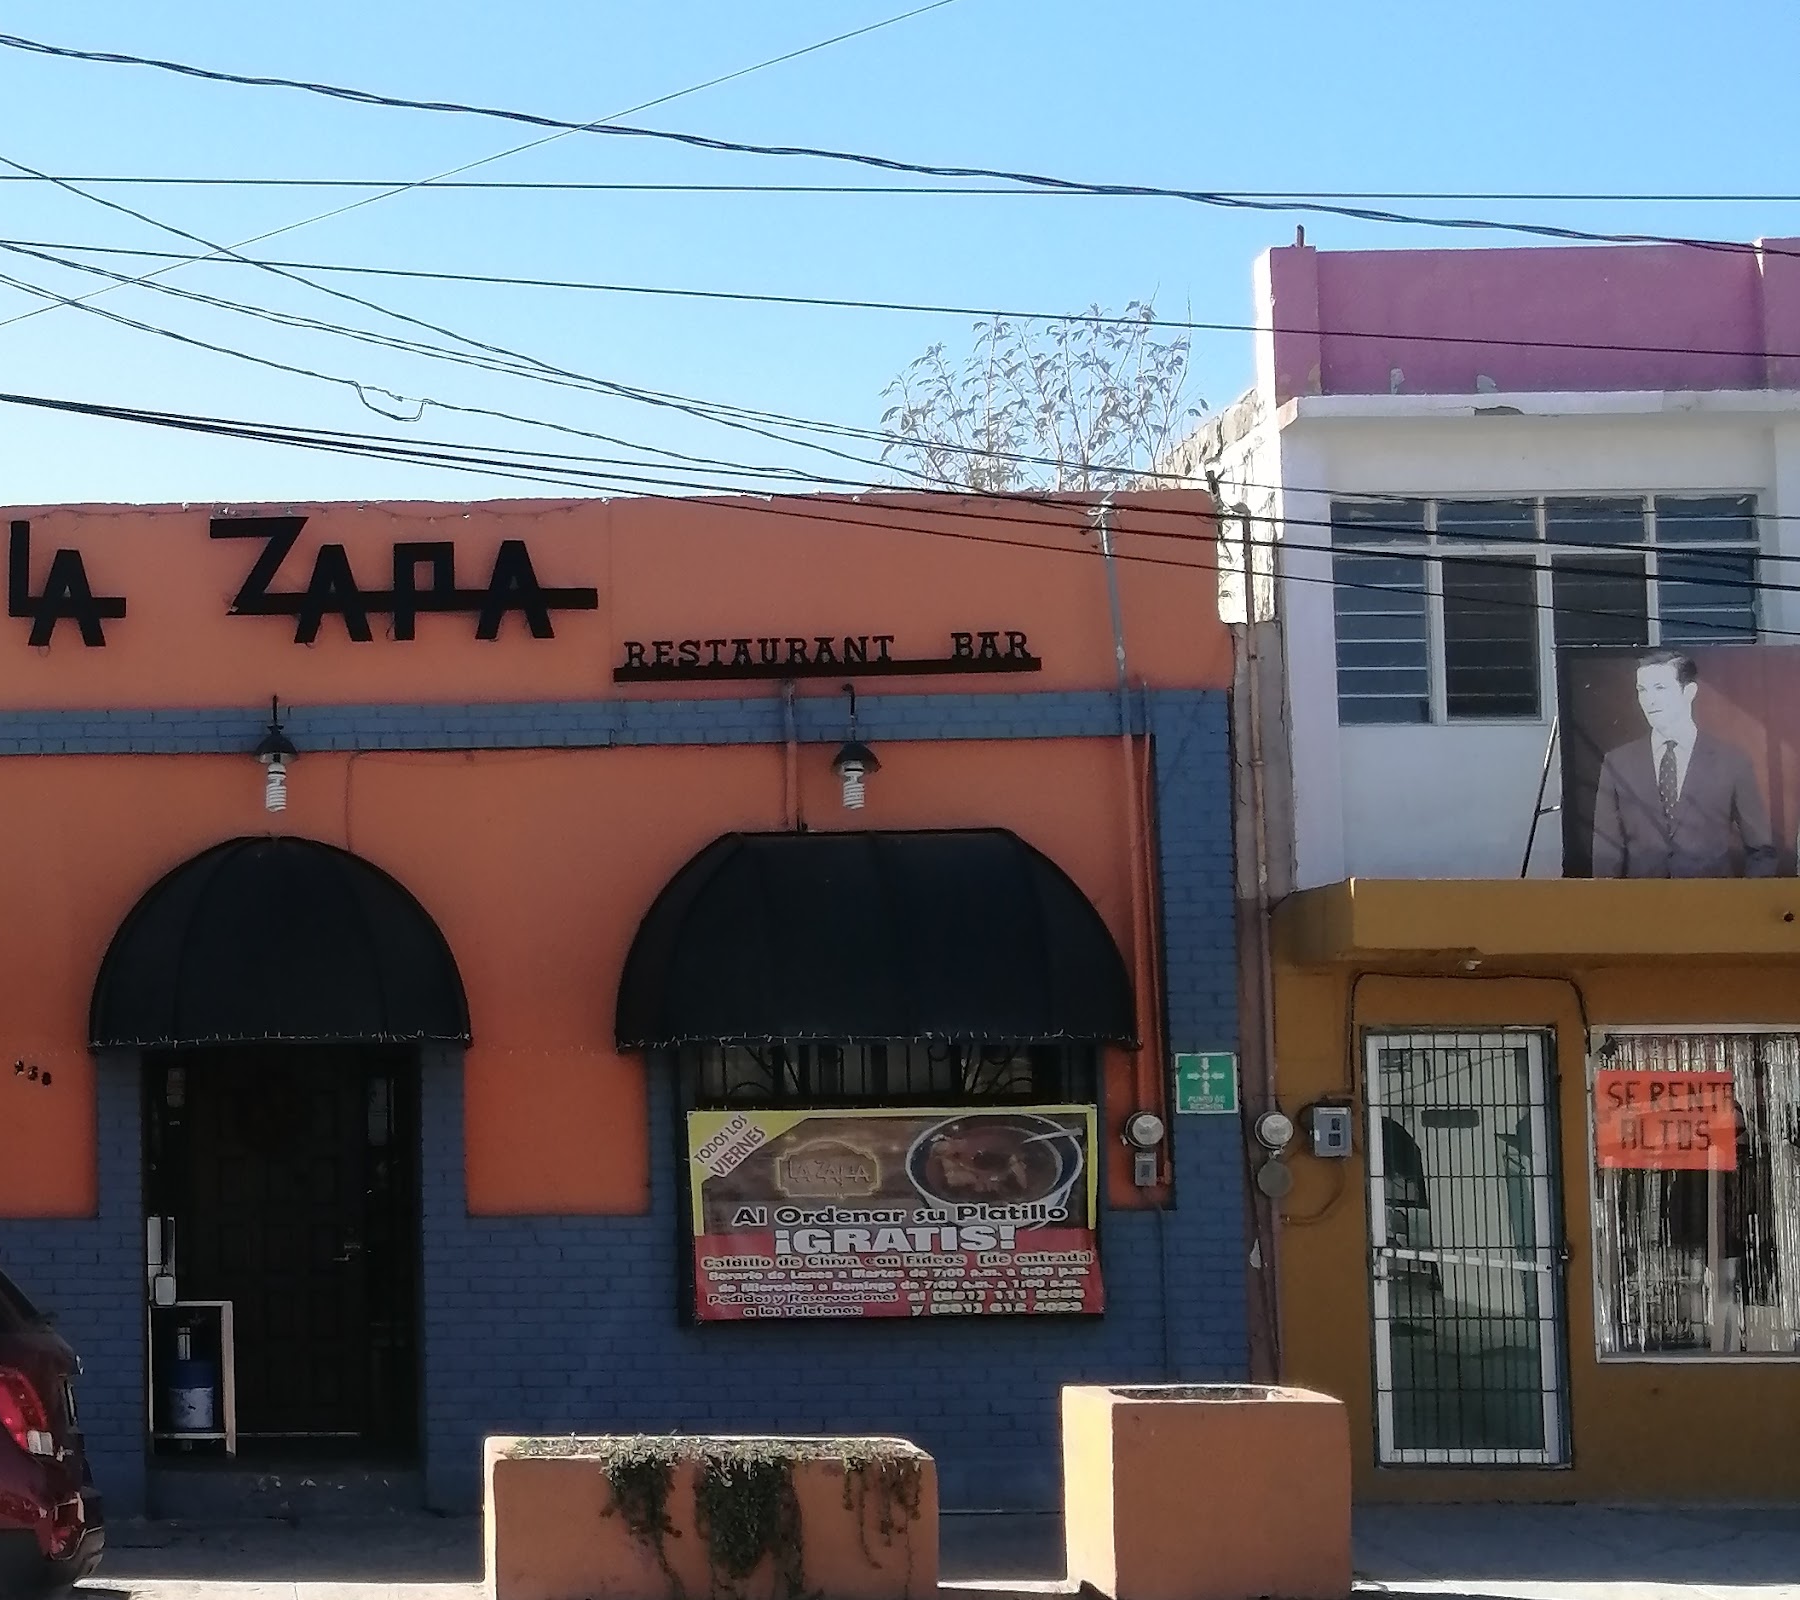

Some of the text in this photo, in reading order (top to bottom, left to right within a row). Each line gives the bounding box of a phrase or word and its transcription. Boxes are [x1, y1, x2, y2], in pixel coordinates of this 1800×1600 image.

[8, 516, 599, 647] LA ZAPA
[623, 630, 1033, 668] RESTAURANT BAR
[1650, 1082, 1734, 1113] RENTA
[693, 1114, 749, 1165] TODOS LOS
[709, 1125, 766, 1176] VIERNES
[1620, 1117, 1712, 1151] ALTOS
[733, 1204, 1068, 1226] Al Ordenar su Platillo
[775, 1225, 1016, 1255] ¡GRATIS!
